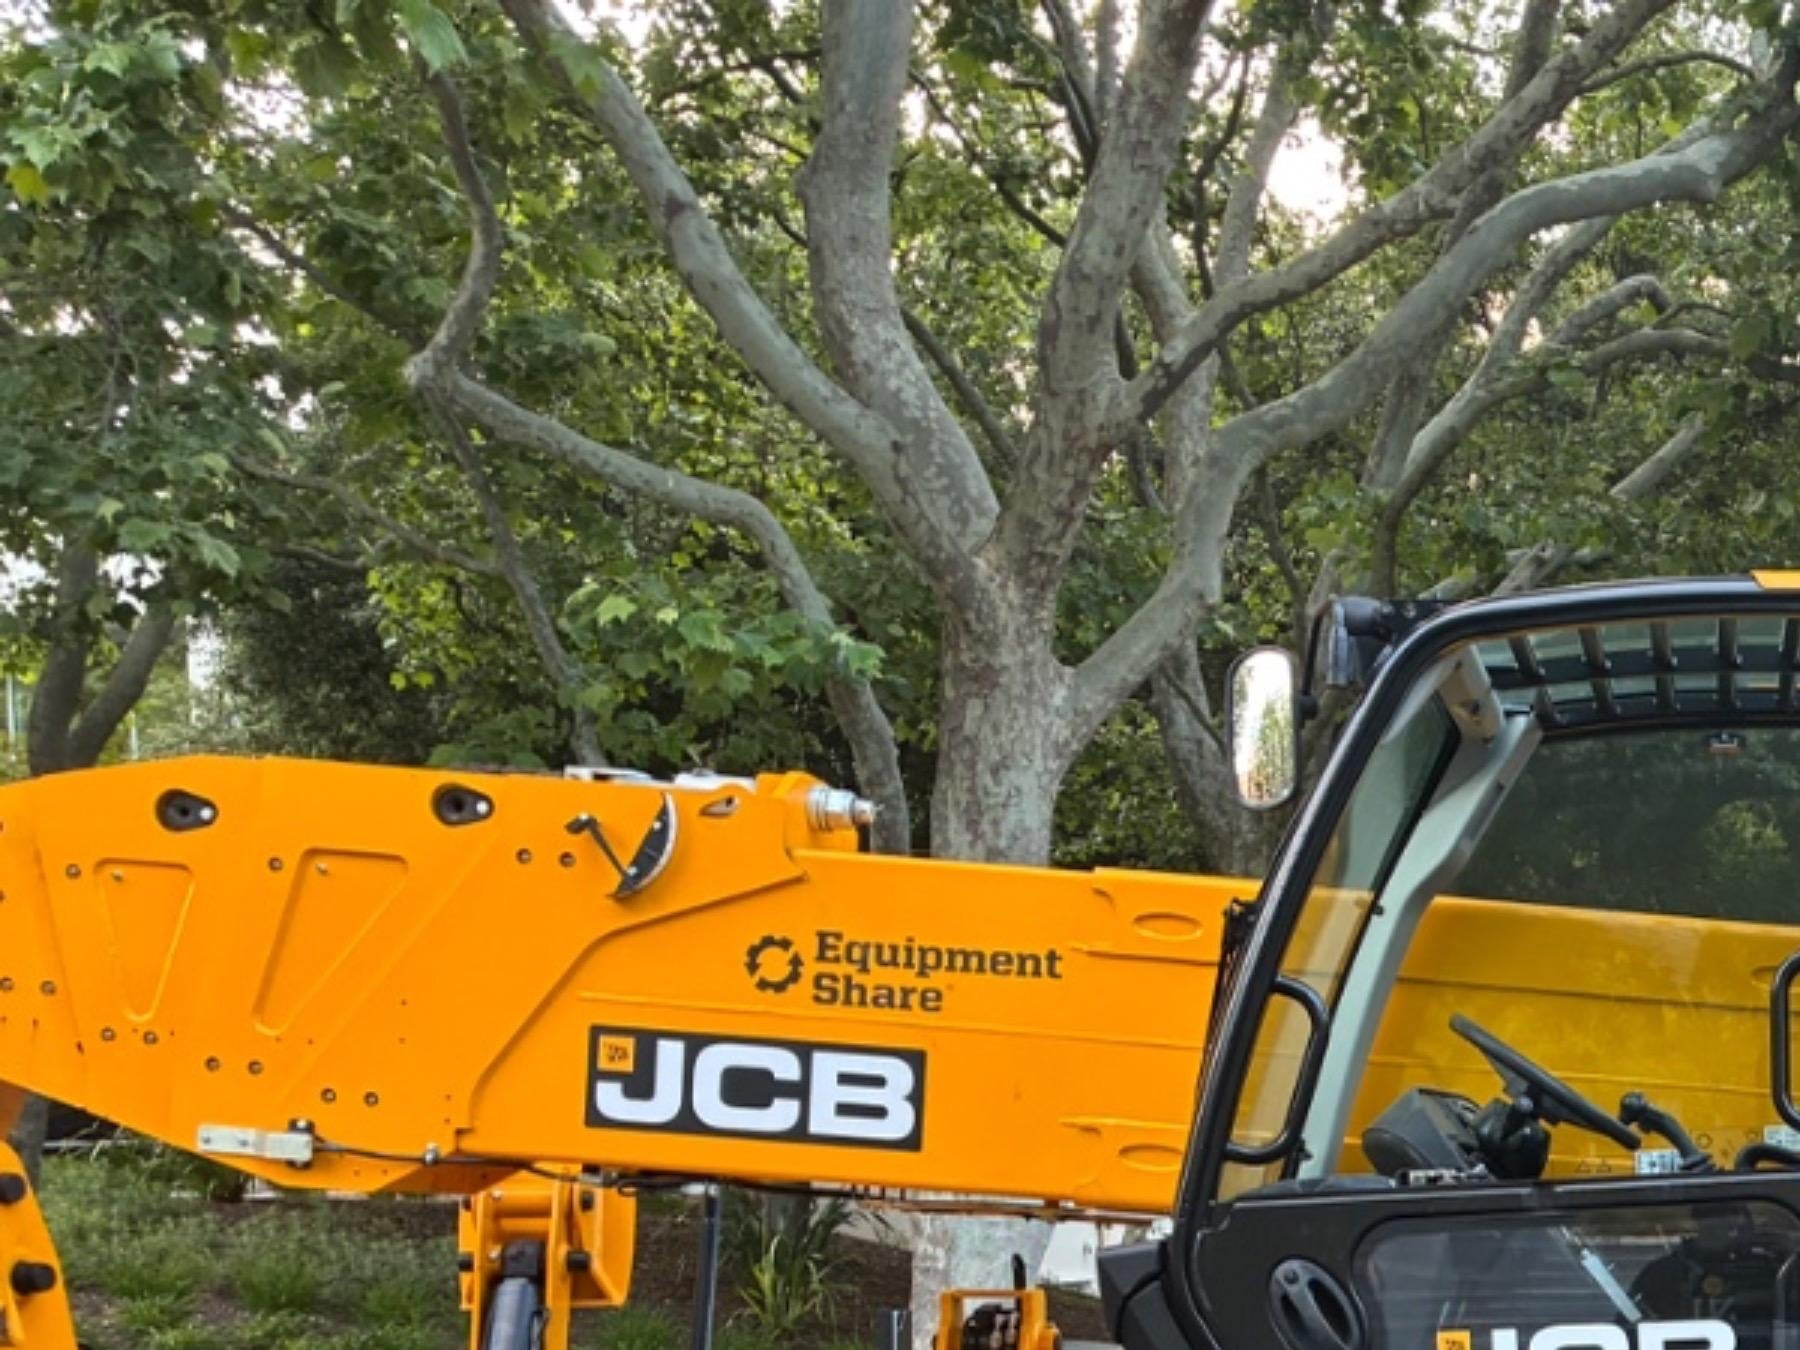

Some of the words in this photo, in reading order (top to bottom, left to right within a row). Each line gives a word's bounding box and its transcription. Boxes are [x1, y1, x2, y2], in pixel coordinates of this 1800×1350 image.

[814, 929, 1063, 979] Equipment
[811, 971, 944, 1013] Share
[595, 1038, 917, 1142] JCB
